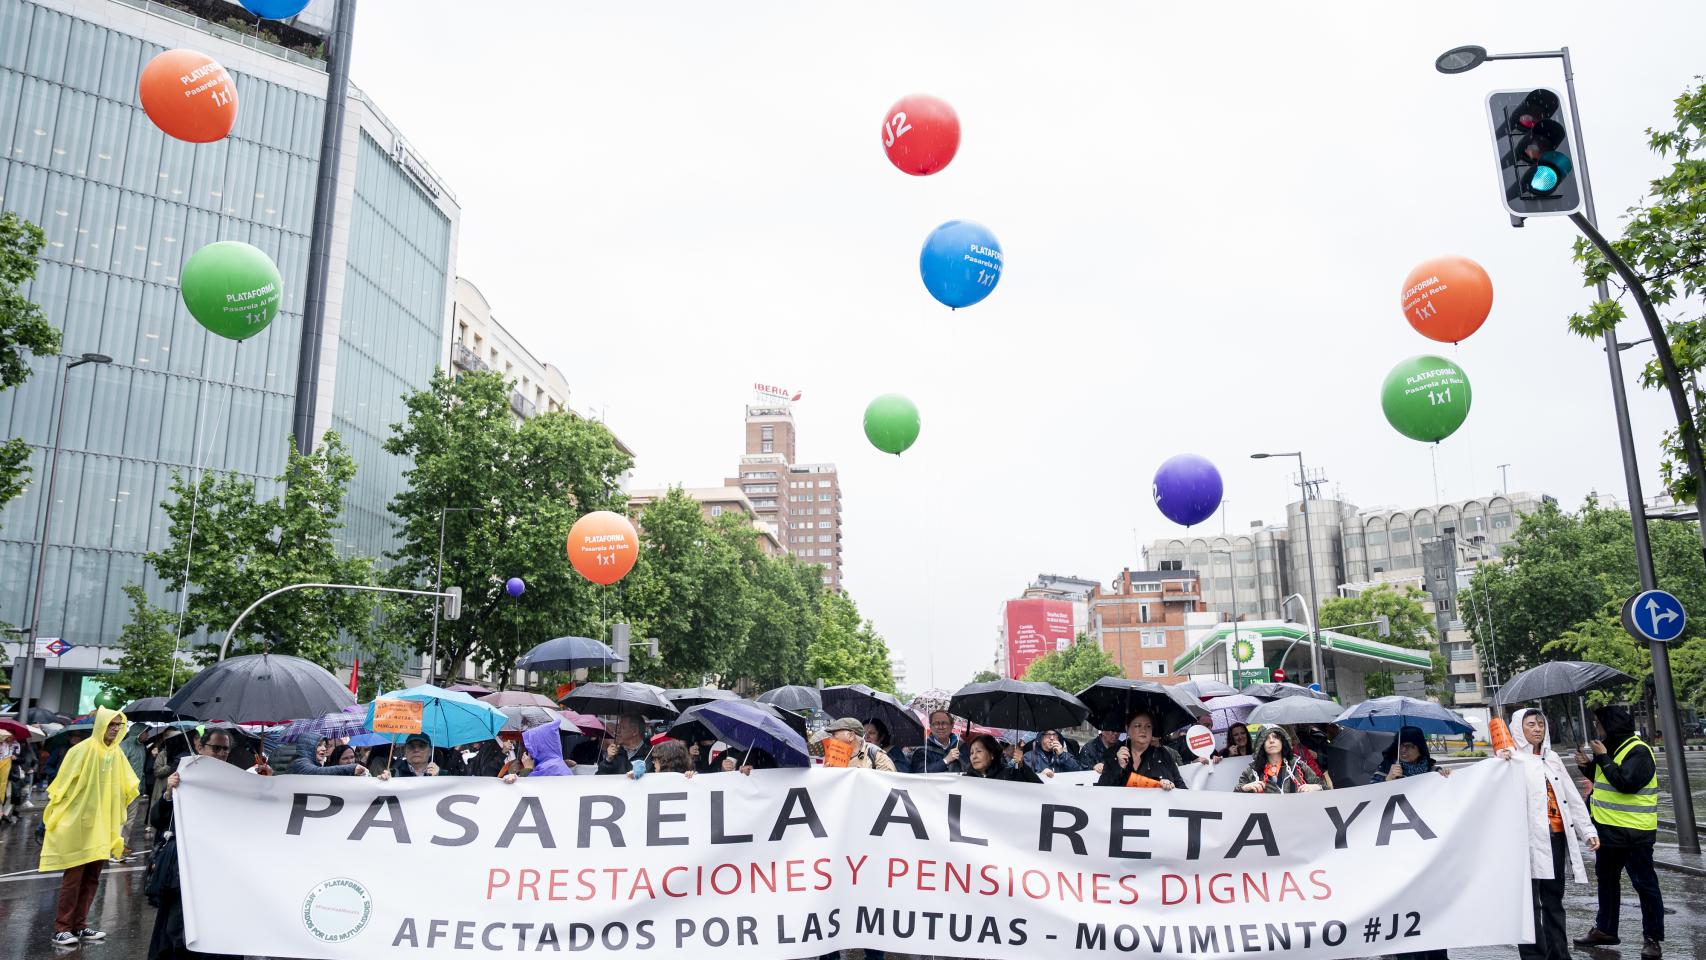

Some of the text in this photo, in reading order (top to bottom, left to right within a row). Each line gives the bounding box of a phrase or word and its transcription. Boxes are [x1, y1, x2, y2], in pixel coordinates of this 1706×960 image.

[211, 84, 232, 107] 1x1
[885, 111, 912, 148] J2
[977, 269, 996, 287] 1x1
[226, 282, 275, 302] PLATAFORMA
[245, 308, 267, 325] 1x1
[1415, 300, 1437, 320] 1x1
[1406, 368, 1456, 385] PLATAFORMA
[754, 382, 789, 397] IBERIA
[1405, 381, 1439, 395] Pasarela
[1428, 387, 1451, 405] 1x1
[584, 534, 625, 543] PLATAFORMA
[596, 552, 616, 566] 1x1
[285, 787, 1437, 861] PASARELA AL RETA YA
[323, 879, 364, 896] PLATAFORMA
[486, 855, 1333, 906] PRESTACIONES Y PENSIONES DIGNAS
[303, 892, 316, 929] AFECTADOS
[310, 926, 326, 939] POR
[324, 933, 338, 941] LAS
[392, 917, 656, 951] AFECTADOS
[675, 915, 759, 949] POR
[777, 908, 841, 944] LAS
[855, 905, 1028, 946] MUTUAS
[1075, 920, 1348, 954] MOVIMIENTO
[1363, 910, 1422, 943] #J2
